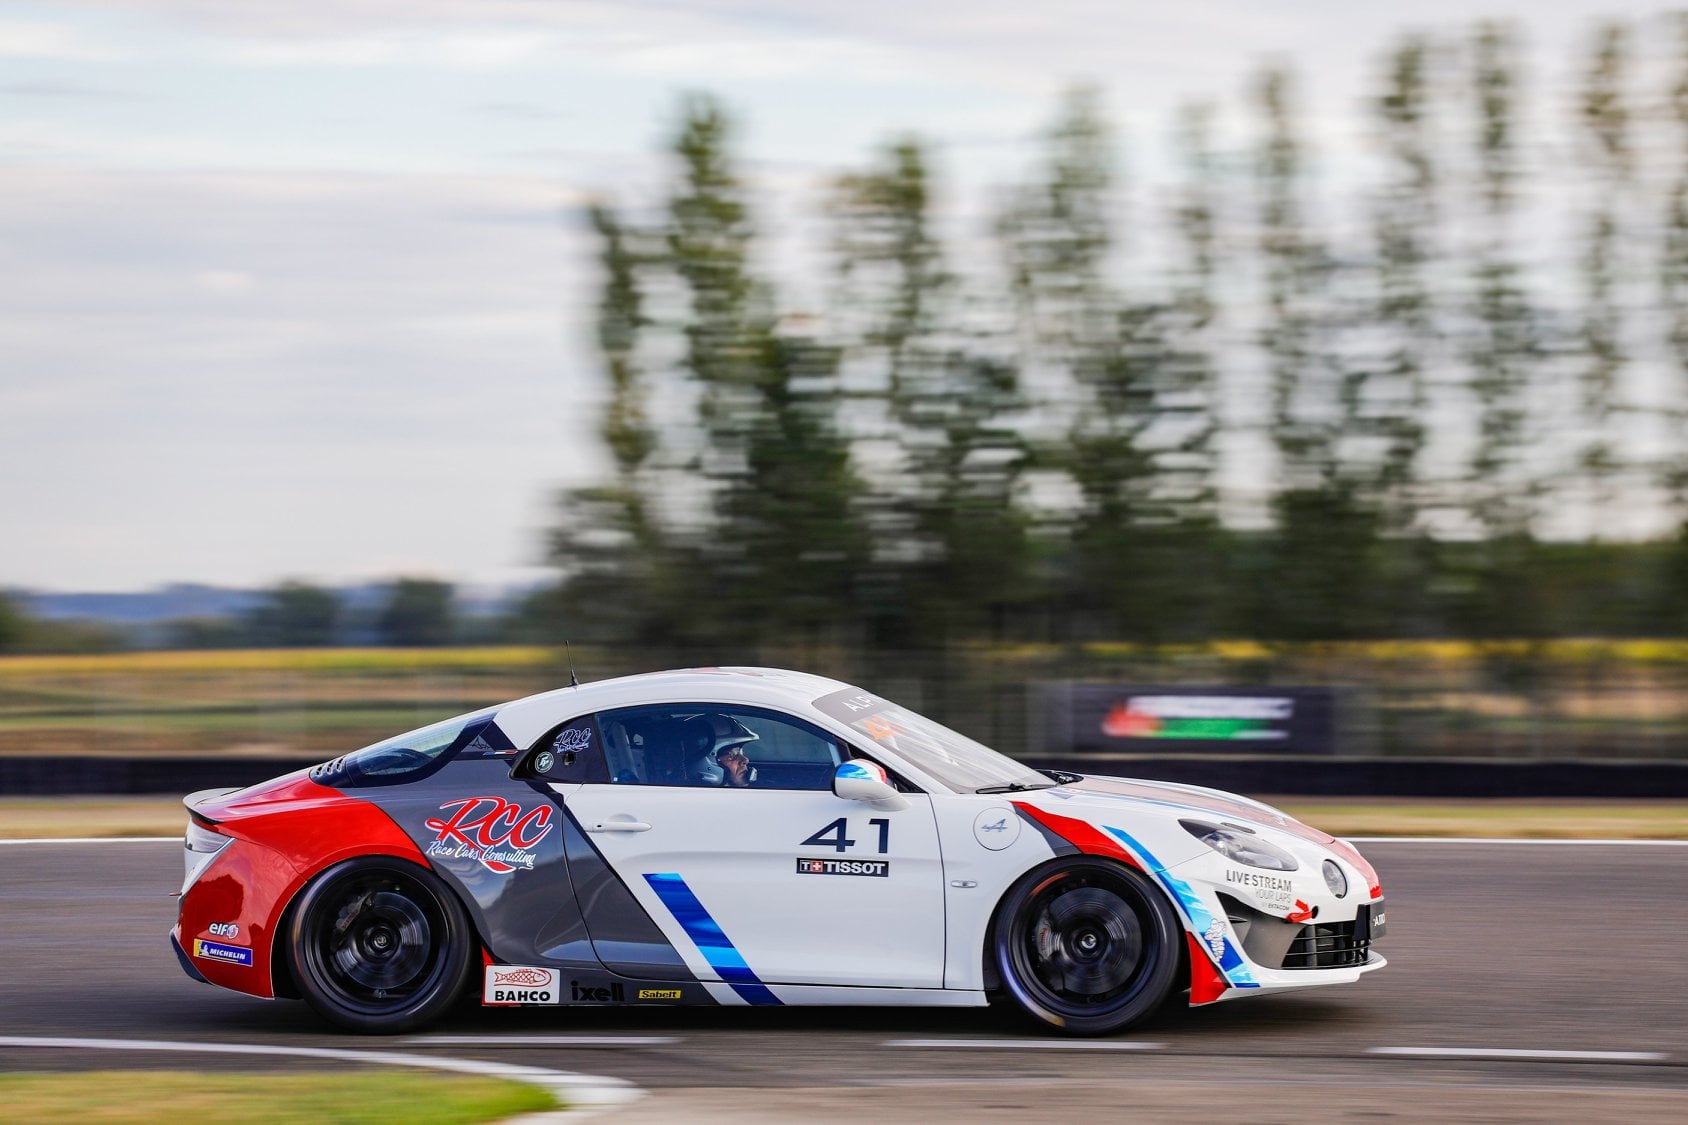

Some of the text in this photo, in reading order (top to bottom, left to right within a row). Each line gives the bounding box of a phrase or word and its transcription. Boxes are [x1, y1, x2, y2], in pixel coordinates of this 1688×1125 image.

[425, 796, 553, 874] RCC
[800, 817, 889, 853] 41
[426, 840, 536, 870] Race Cars Consulting
[823, 861, 886, 875] TISSOT
[1226, 869, 1292, 893] LIVE STREAM
[1255, 888, 1291, 903] YOUR LAPS
[209, 923, 228, 936] elf
[209, 948, 246, 960] MICHELIN
[495, 991, 551, 1002] BAHCO
[570, 980, 625, 1002] ixell
[641, 990, 678, 999] Sabelt
